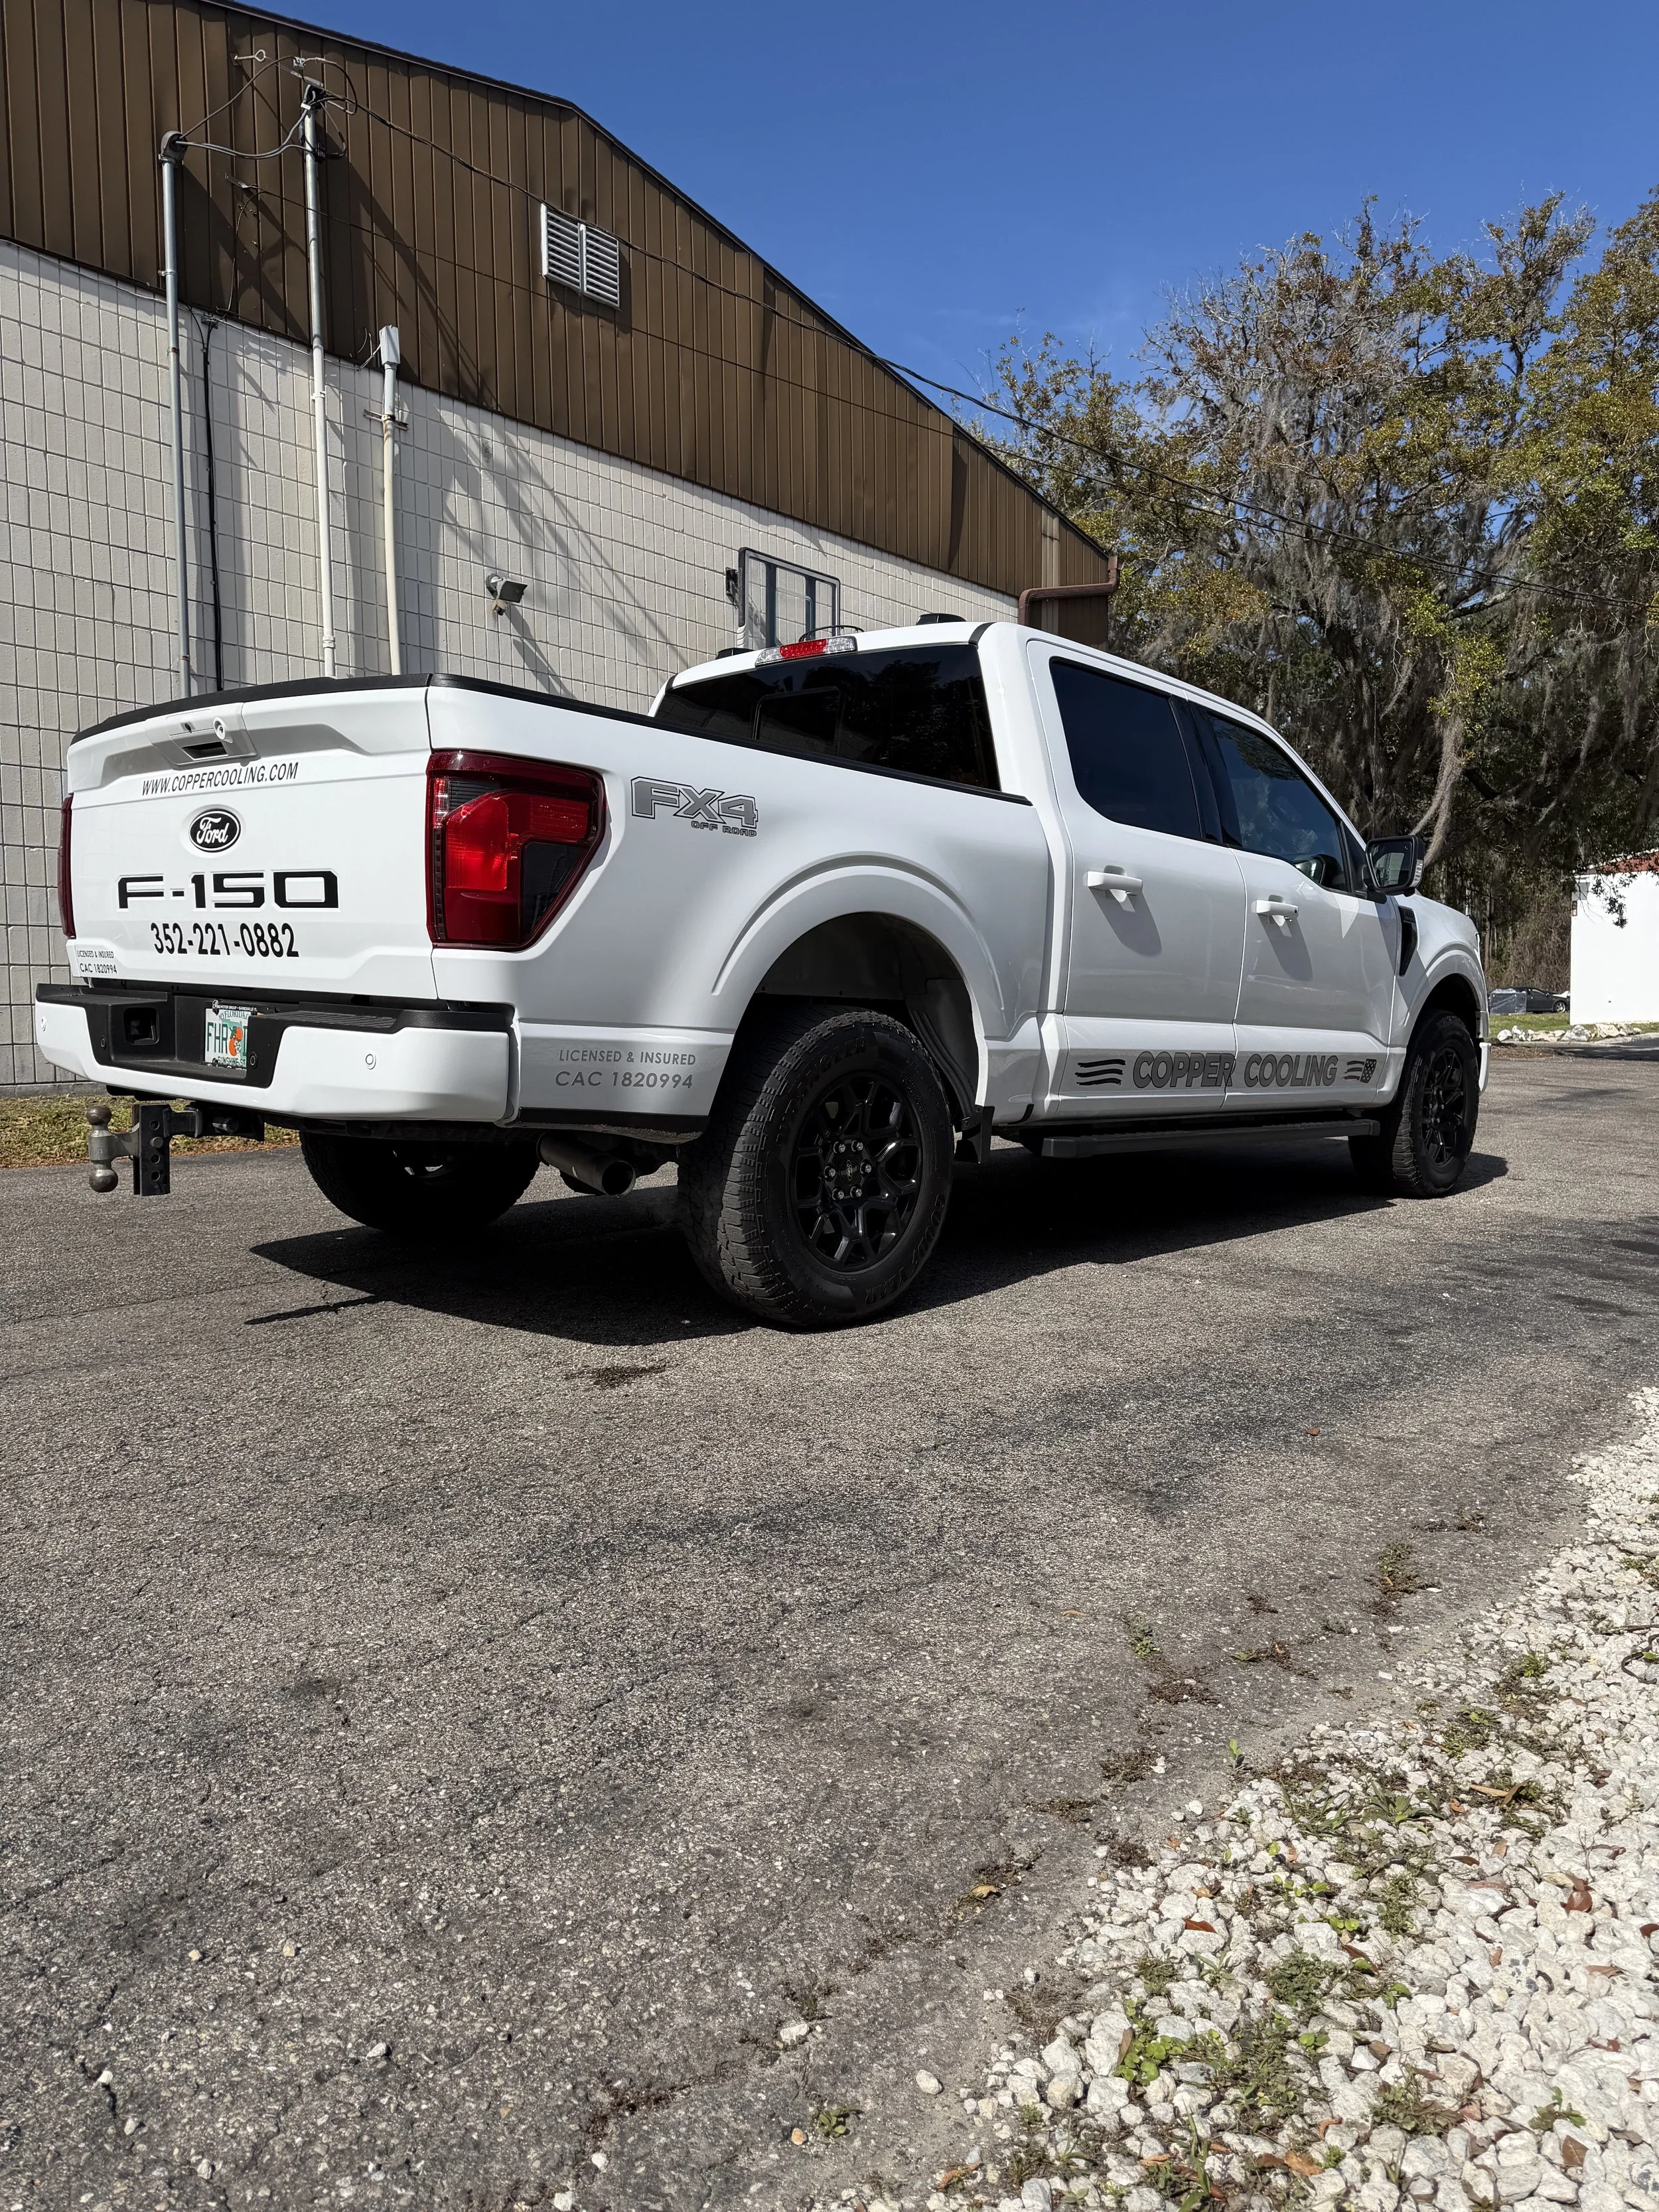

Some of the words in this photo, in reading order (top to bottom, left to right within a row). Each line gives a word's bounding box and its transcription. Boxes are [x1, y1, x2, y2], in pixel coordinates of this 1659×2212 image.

[141, 762, 299, 796] WWW.COPPERCOOLING.COM
[630, 776, 758, 829] FX4
[196, 816, 230, 844] Ford
[691, 820, 718, 831] OFF
[722, 826, 757, 837] ROAD
[117, 870, 339, 909] F-150
[150, 922, 299, 958] 352-221-0882
[80, 963, 93, 973] CAC
[94, 964, 117, 974] 1820994
[207, 1022, 228, 1054] FHR
[559, 1049, 622, 1062] LICENSED
[626, 1051, 635, 1063] &
[640, 1051, 696, 1065] INSURED
[1133, 1051, 1235, 1088] COPPER
[1244, 1053, 1339, 1088] COOLING
[555, 1070, 603, 1086] CAC
[612, 1071, 693, 1088] 1820994
